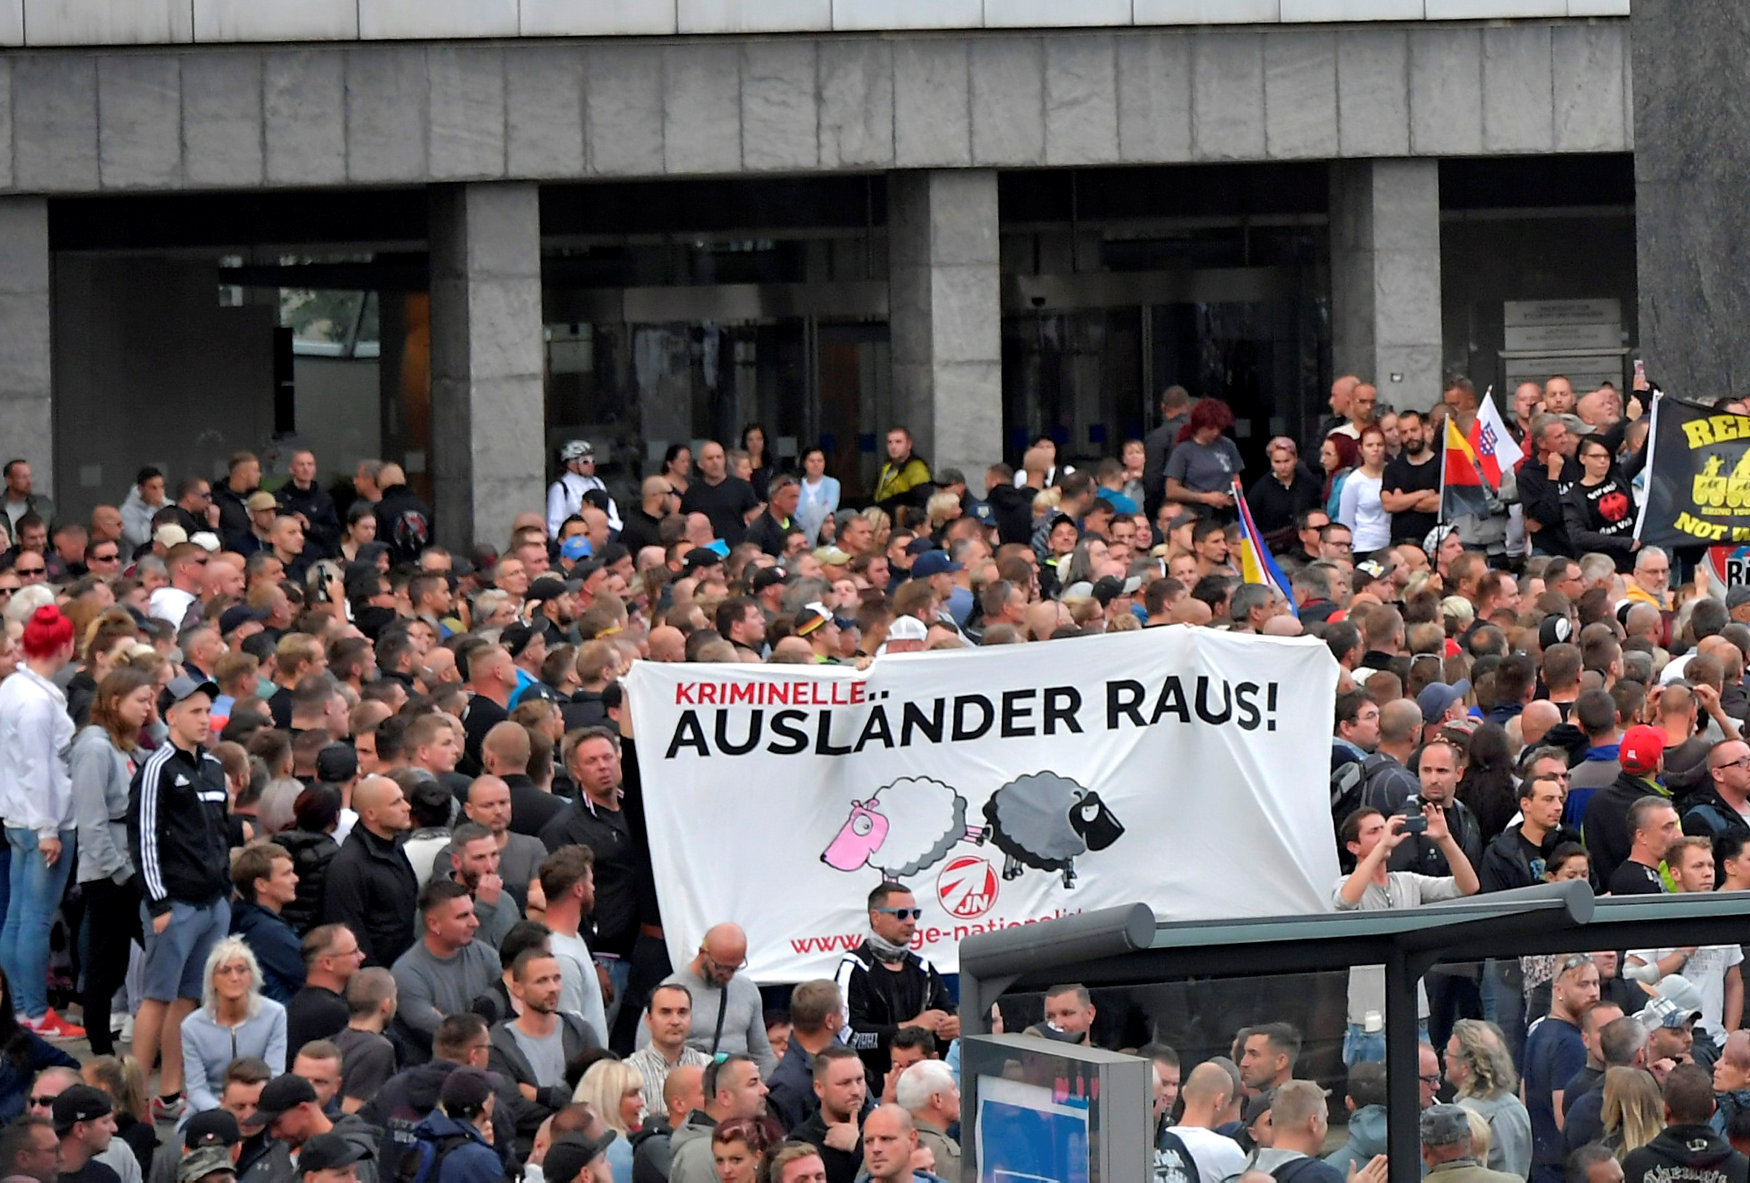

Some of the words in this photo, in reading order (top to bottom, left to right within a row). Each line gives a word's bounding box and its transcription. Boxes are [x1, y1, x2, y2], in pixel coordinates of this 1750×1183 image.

[1674, 511, 1729, 541] NOT
[674, 680, 868, 707] KRIMINELLE
[665, 684, 1084, 760] AUSLÄNDER
[1105, 674, 1279, 733] RAUS!
[957, 894, 990, 914] JN
